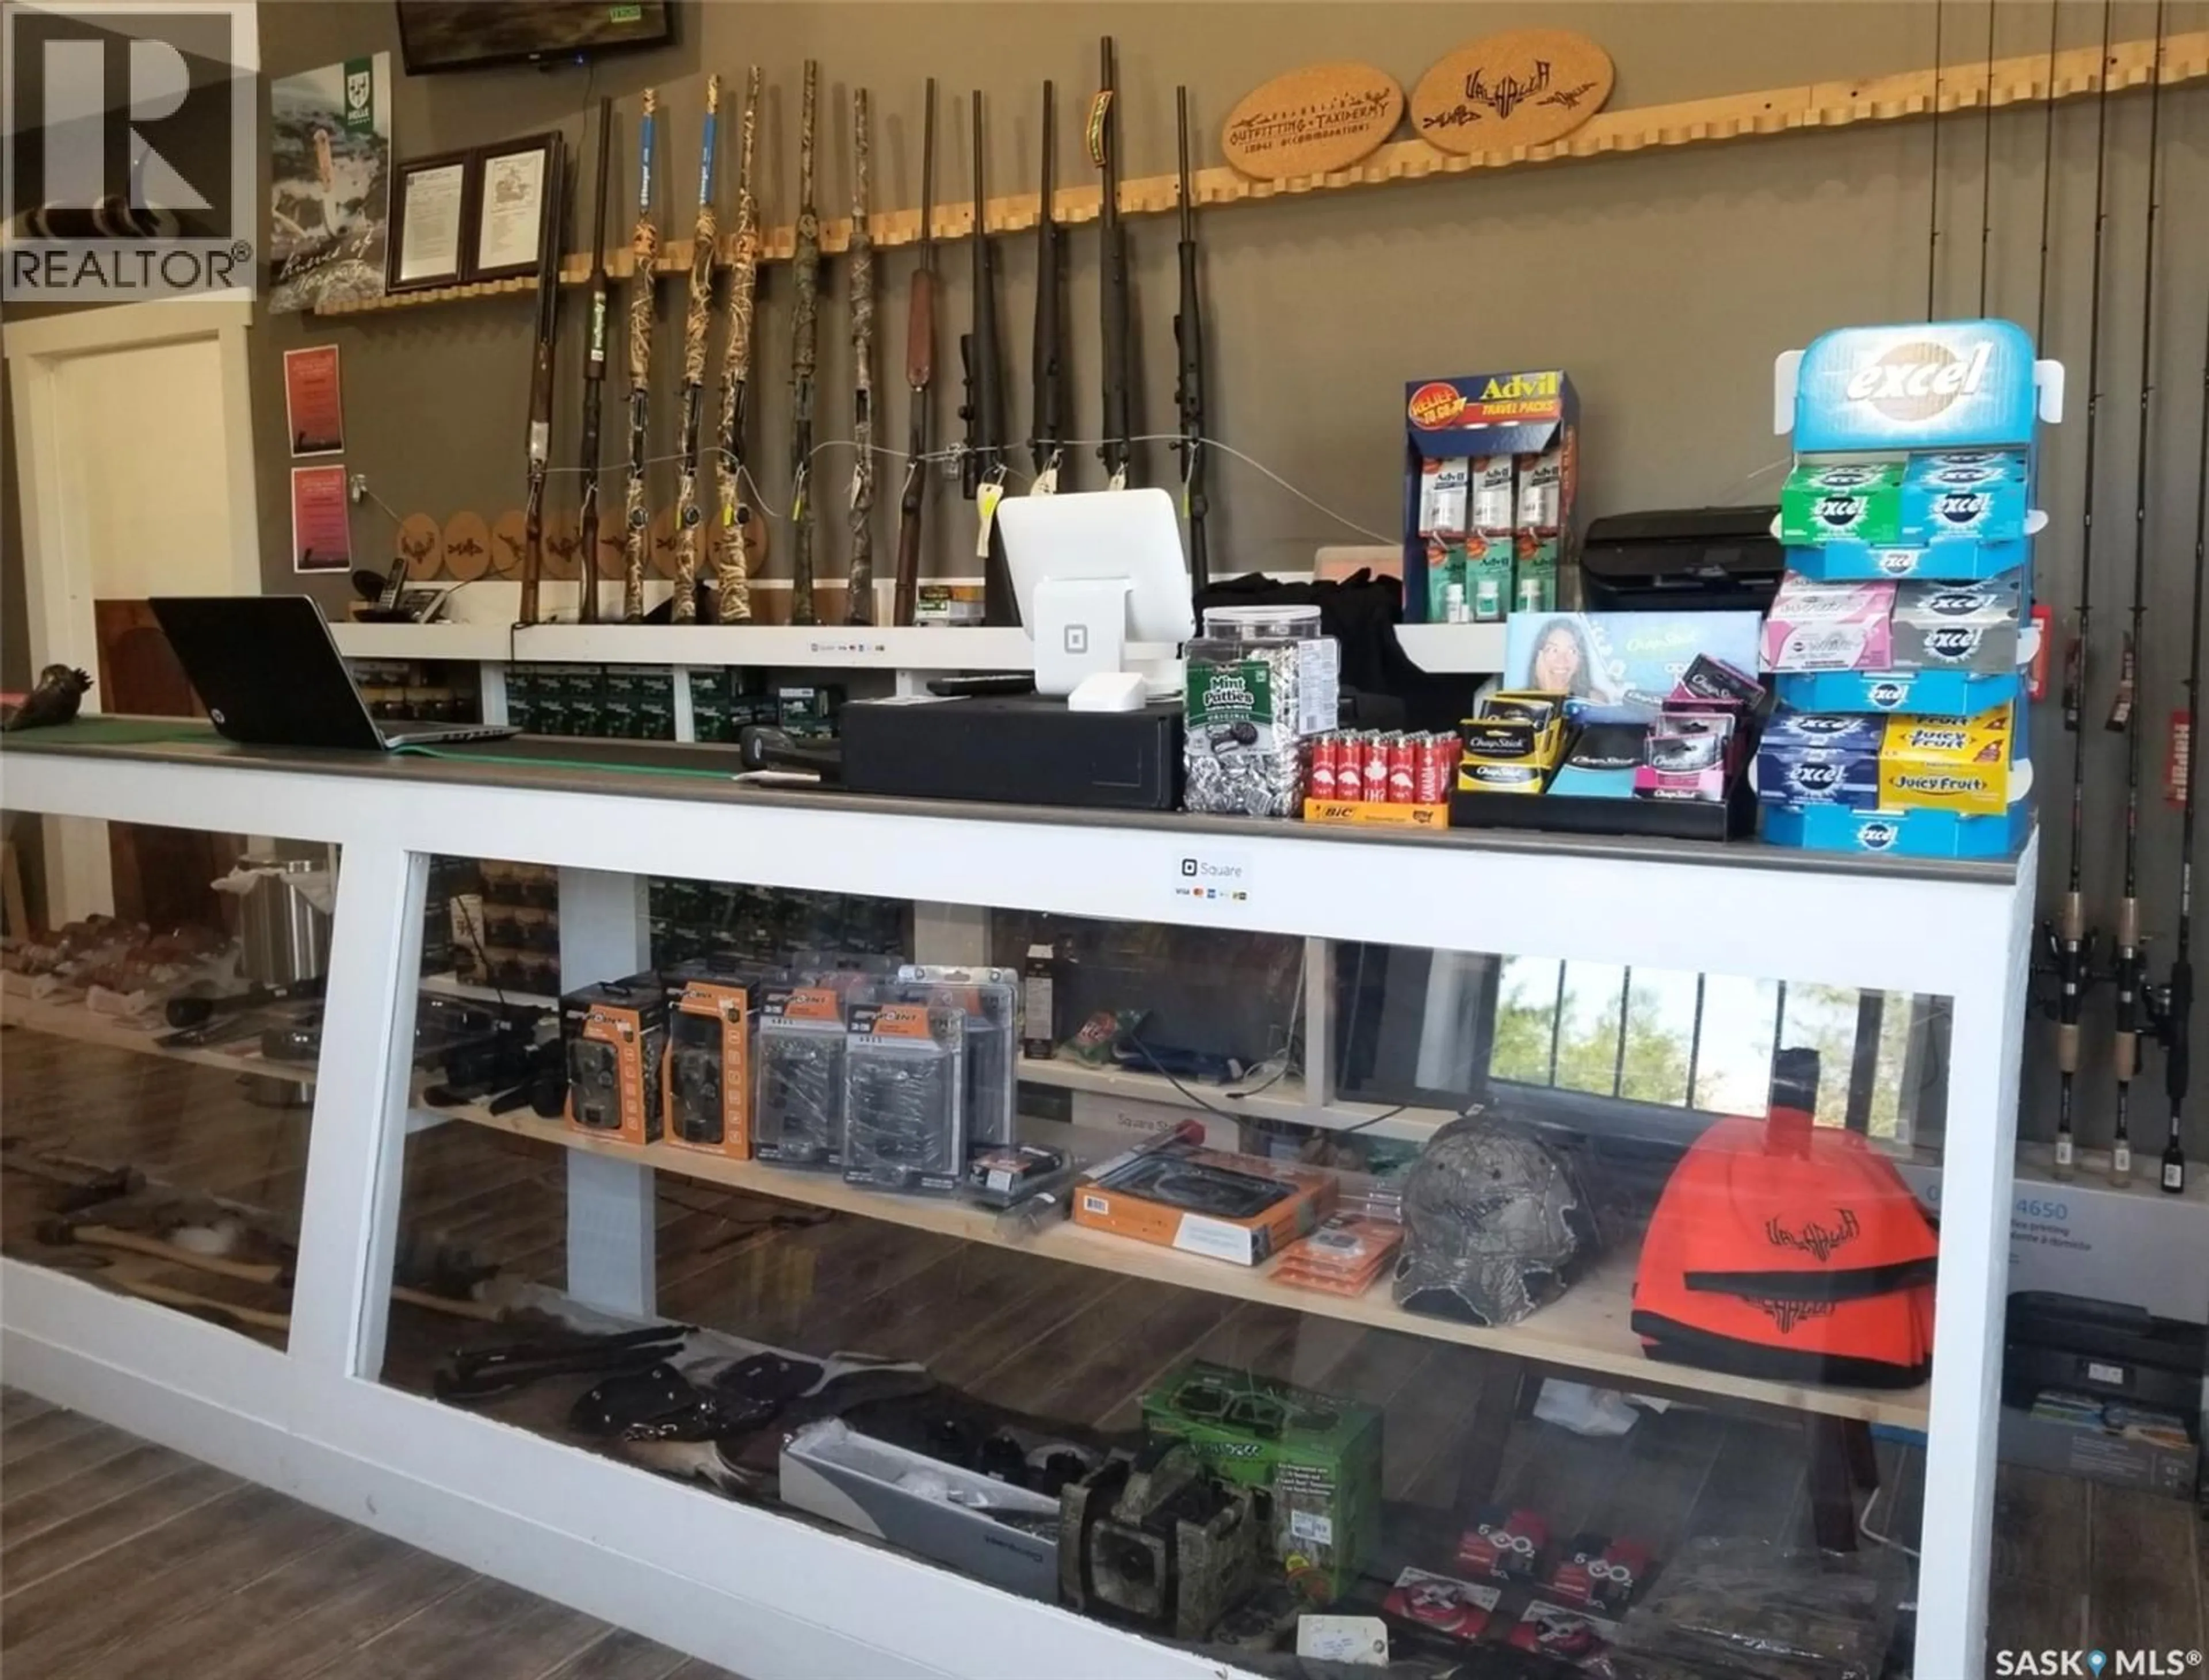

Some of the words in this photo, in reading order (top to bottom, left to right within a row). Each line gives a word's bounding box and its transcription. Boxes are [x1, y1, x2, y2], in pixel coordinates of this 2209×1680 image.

[1230, 119, 1306, 145] OUTFITTING
[1316, 102, 1389, 128] TAXIDERMY
[1846, 340, 1994, 400] excel
[1480, 371, 1559, 400] Advil
[1518, 399, 1556, 414] PACKS
[1814, 496, 1868, 517] excel
[1933, 494, 1991, 514] excel
[1924, 627, 1982, 650] excel
[1210, 675, 1246, 690] Mint
[1203, 689, 1255, 706] Patties
[1470, 737, 1523, 749] ChapStick
[1912, 737, 1965, 749] Fruit
[1789, 763, 1845, 782] excel
[1420, 766, 1436, 802] CANADA
[1895, 776, 1937, 791] Juicy
[1940, 777, 1982, 791] Fruit
[1199, 861, 1243, 879] Square
[1117, 1114, 1155, 1133] Square
[1156, 1120, 1177, 1134] St
[2016, 1198, 2069, 1220] 4650
